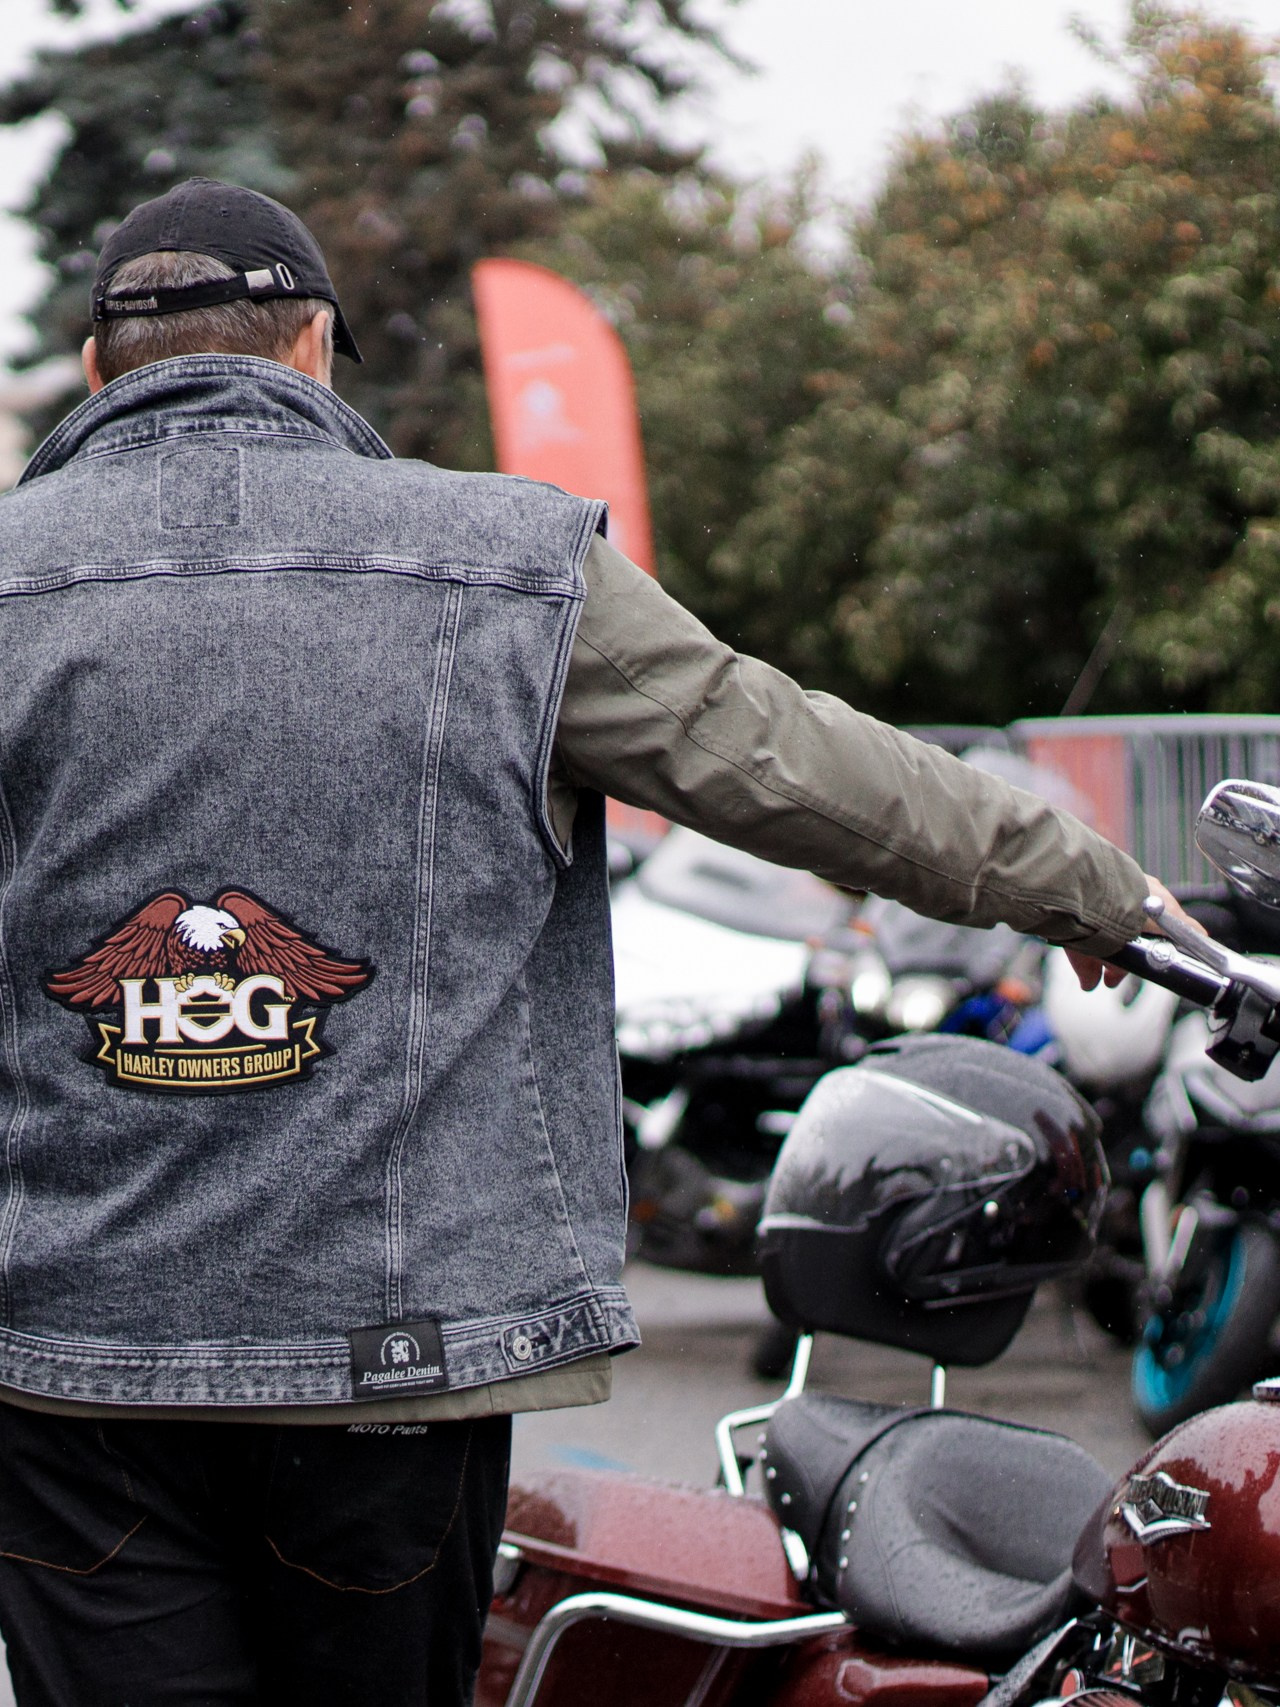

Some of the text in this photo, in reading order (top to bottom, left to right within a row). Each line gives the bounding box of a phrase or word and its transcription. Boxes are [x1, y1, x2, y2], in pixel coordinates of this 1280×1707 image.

[120, 975, 291, 1044] HOG
[123, 1047, 292, 1079] HARLEY OWNERS GROUP
[363, 1364, 440, 1384] Pagalee Denim
[347, 1423, 389, 1434] MOTO
